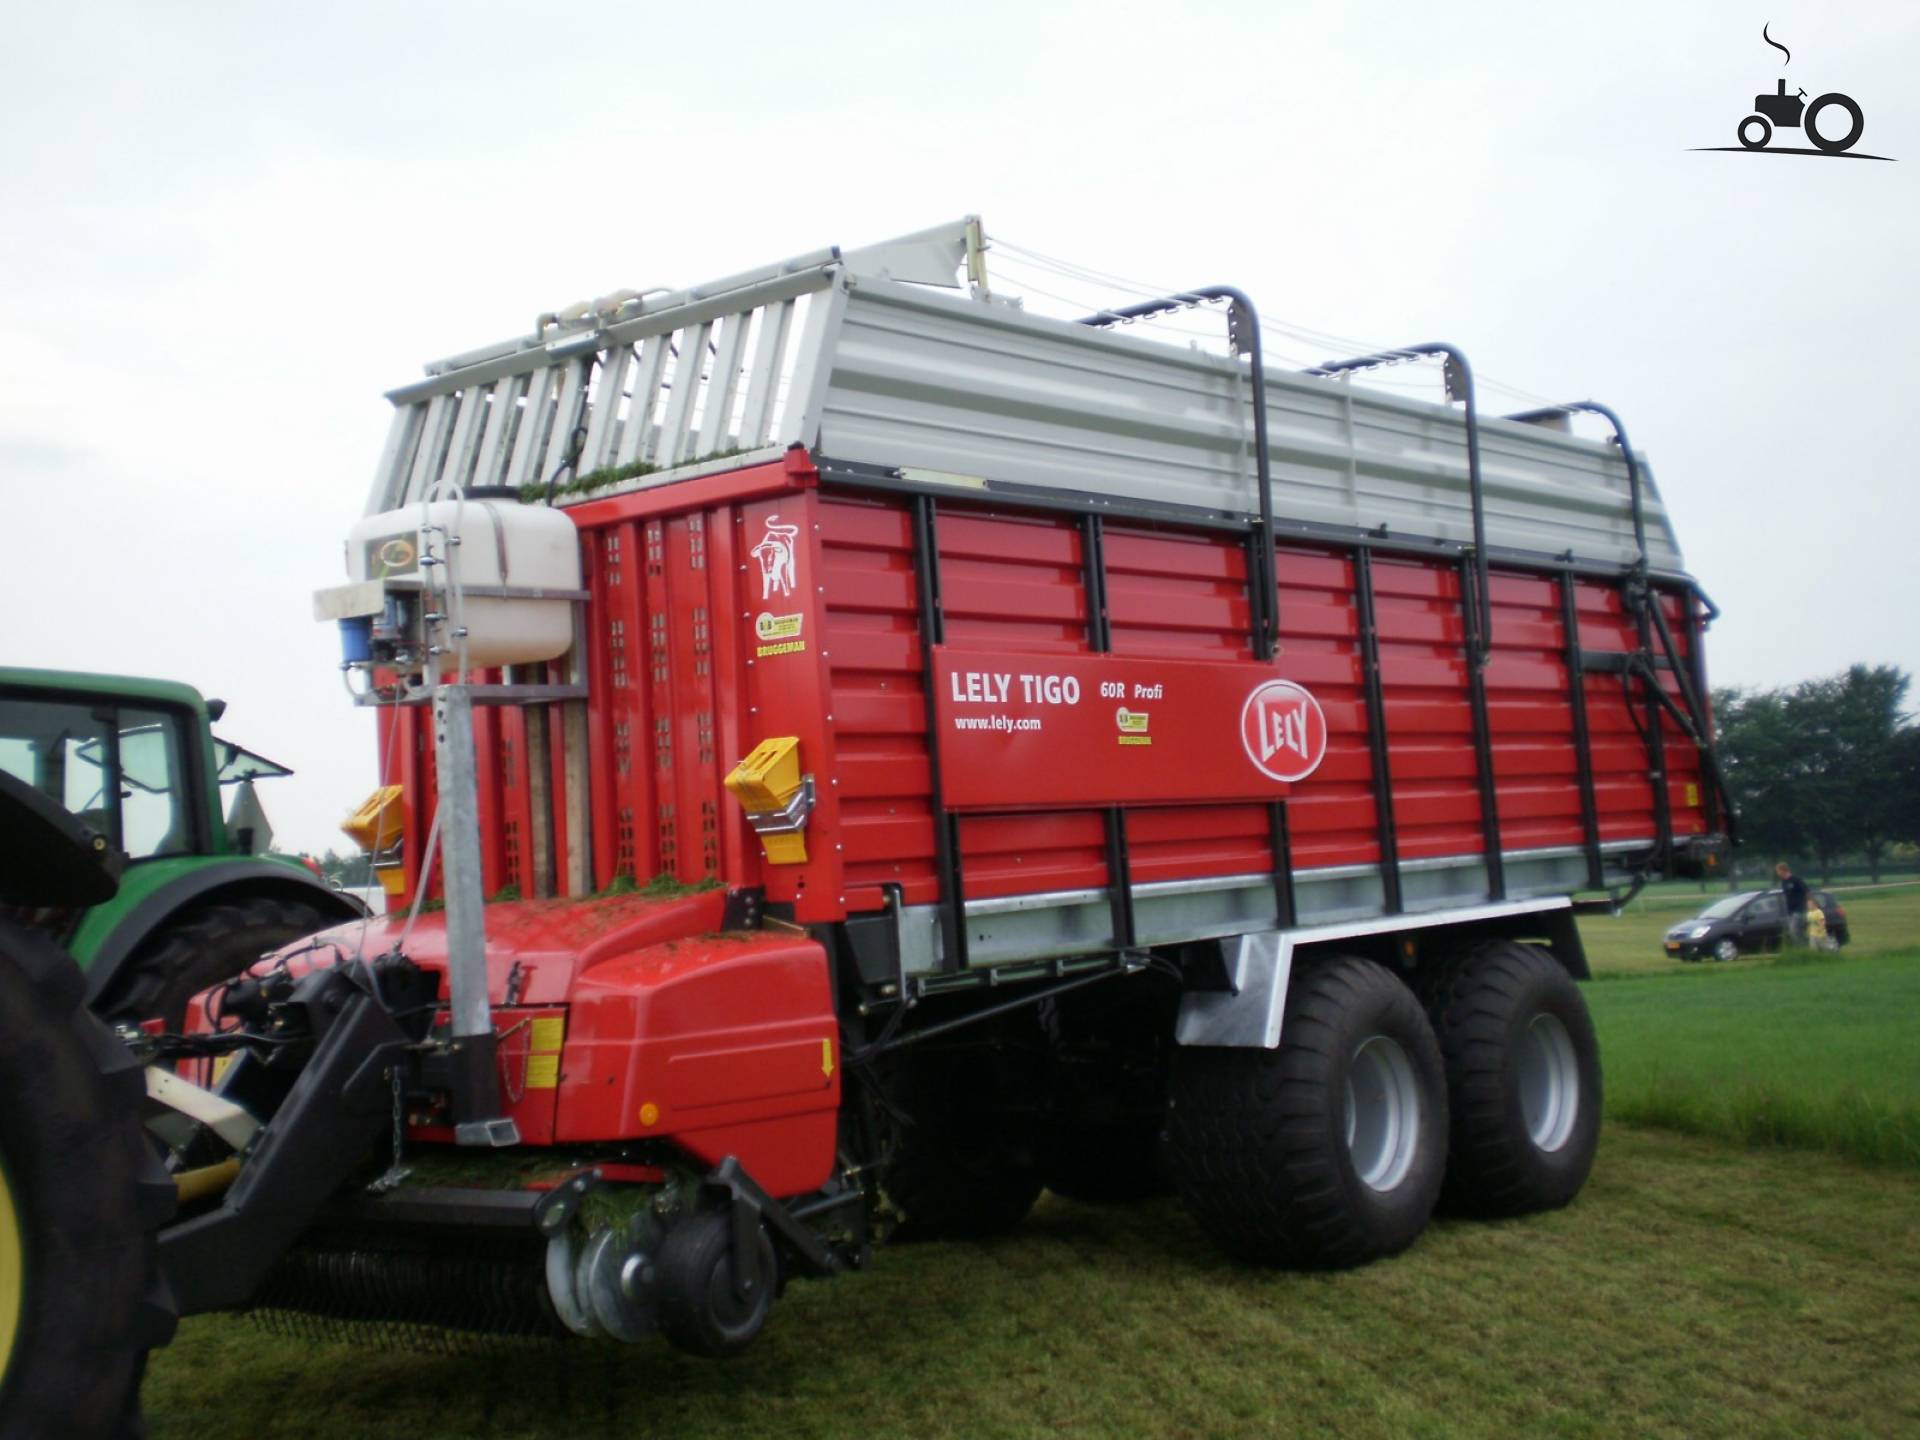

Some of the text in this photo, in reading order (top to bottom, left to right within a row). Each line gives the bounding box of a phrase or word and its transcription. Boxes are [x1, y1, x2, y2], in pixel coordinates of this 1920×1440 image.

[951, 671, 1163, 706] LELY TIGO 60R Profi
[955, 714, 1041, 733] www.lely.com
[1257, 699, 1309, 763] LELY
